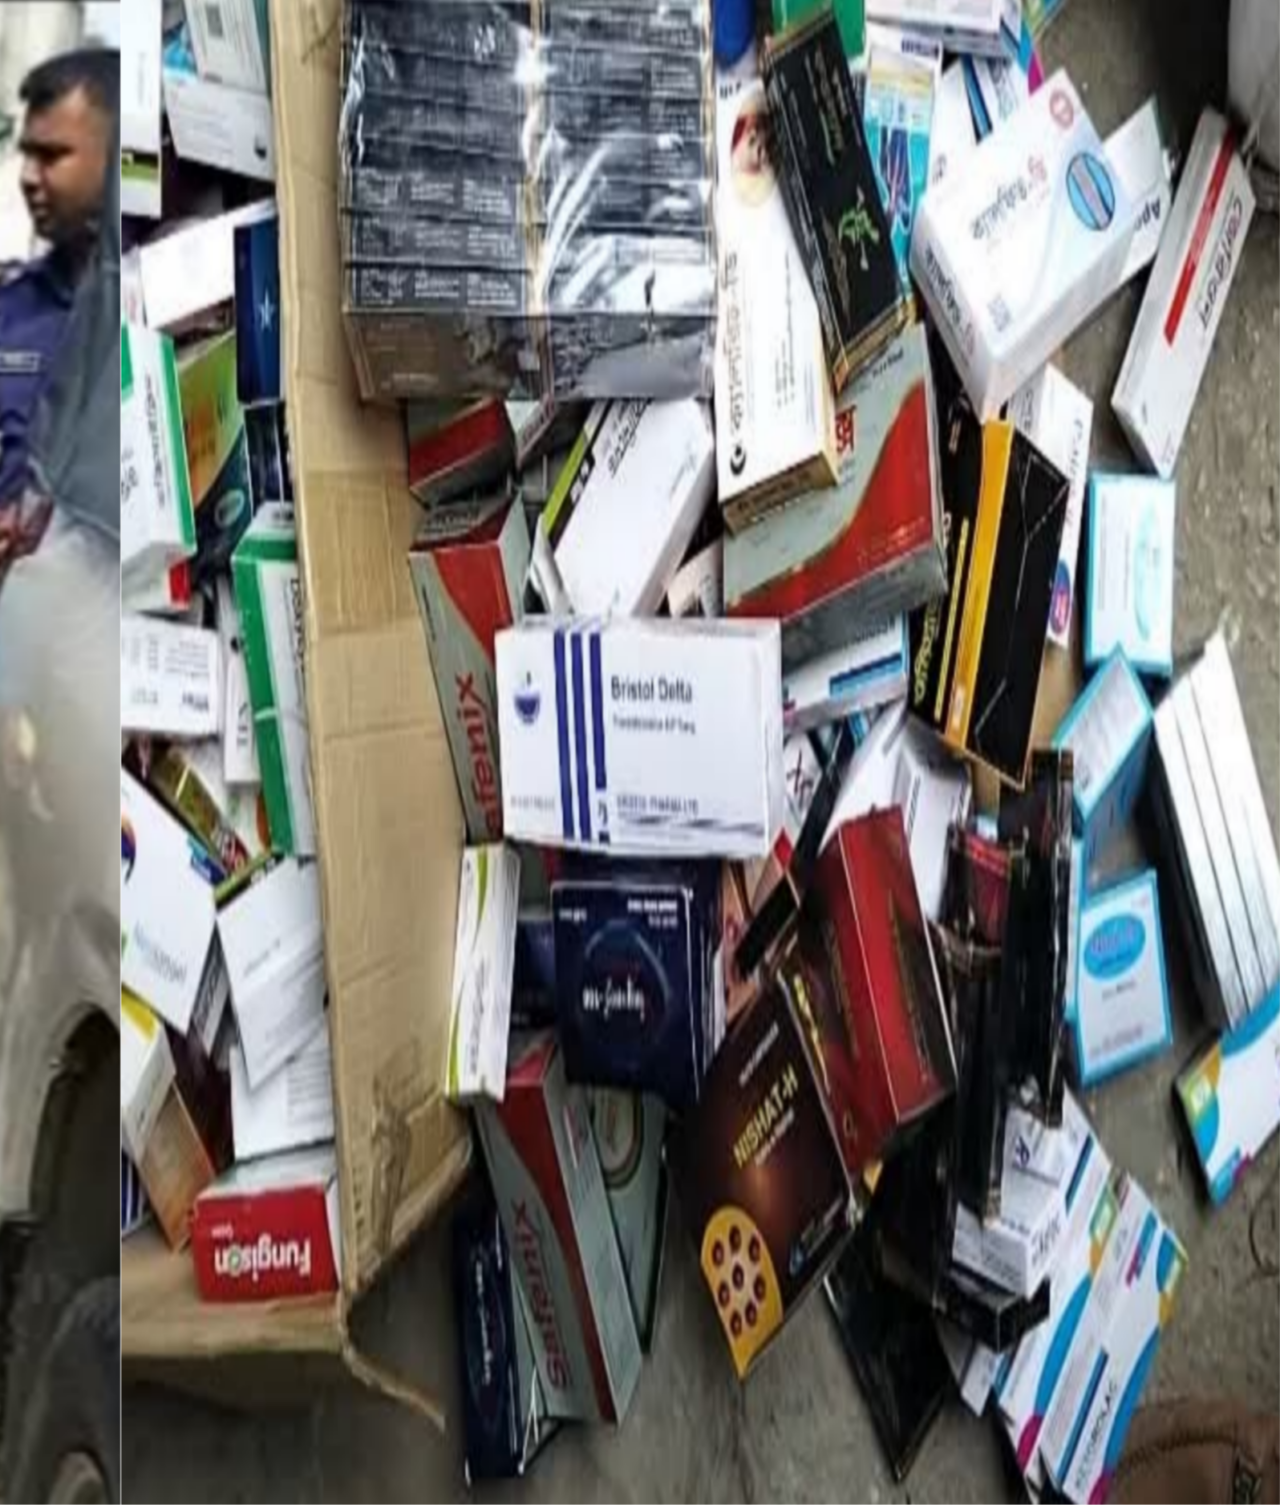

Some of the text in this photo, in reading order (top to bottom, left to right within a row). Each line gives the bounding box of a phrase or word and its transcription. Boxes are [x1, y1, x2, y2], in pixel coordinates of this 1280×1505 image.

[611, 674, 655, 701] Bristol
[455, 671, 506, 842] afenix
[733, 1062, 800, 1170] NISHAT-H
[214, 1231, 312, 1283] Fungison
